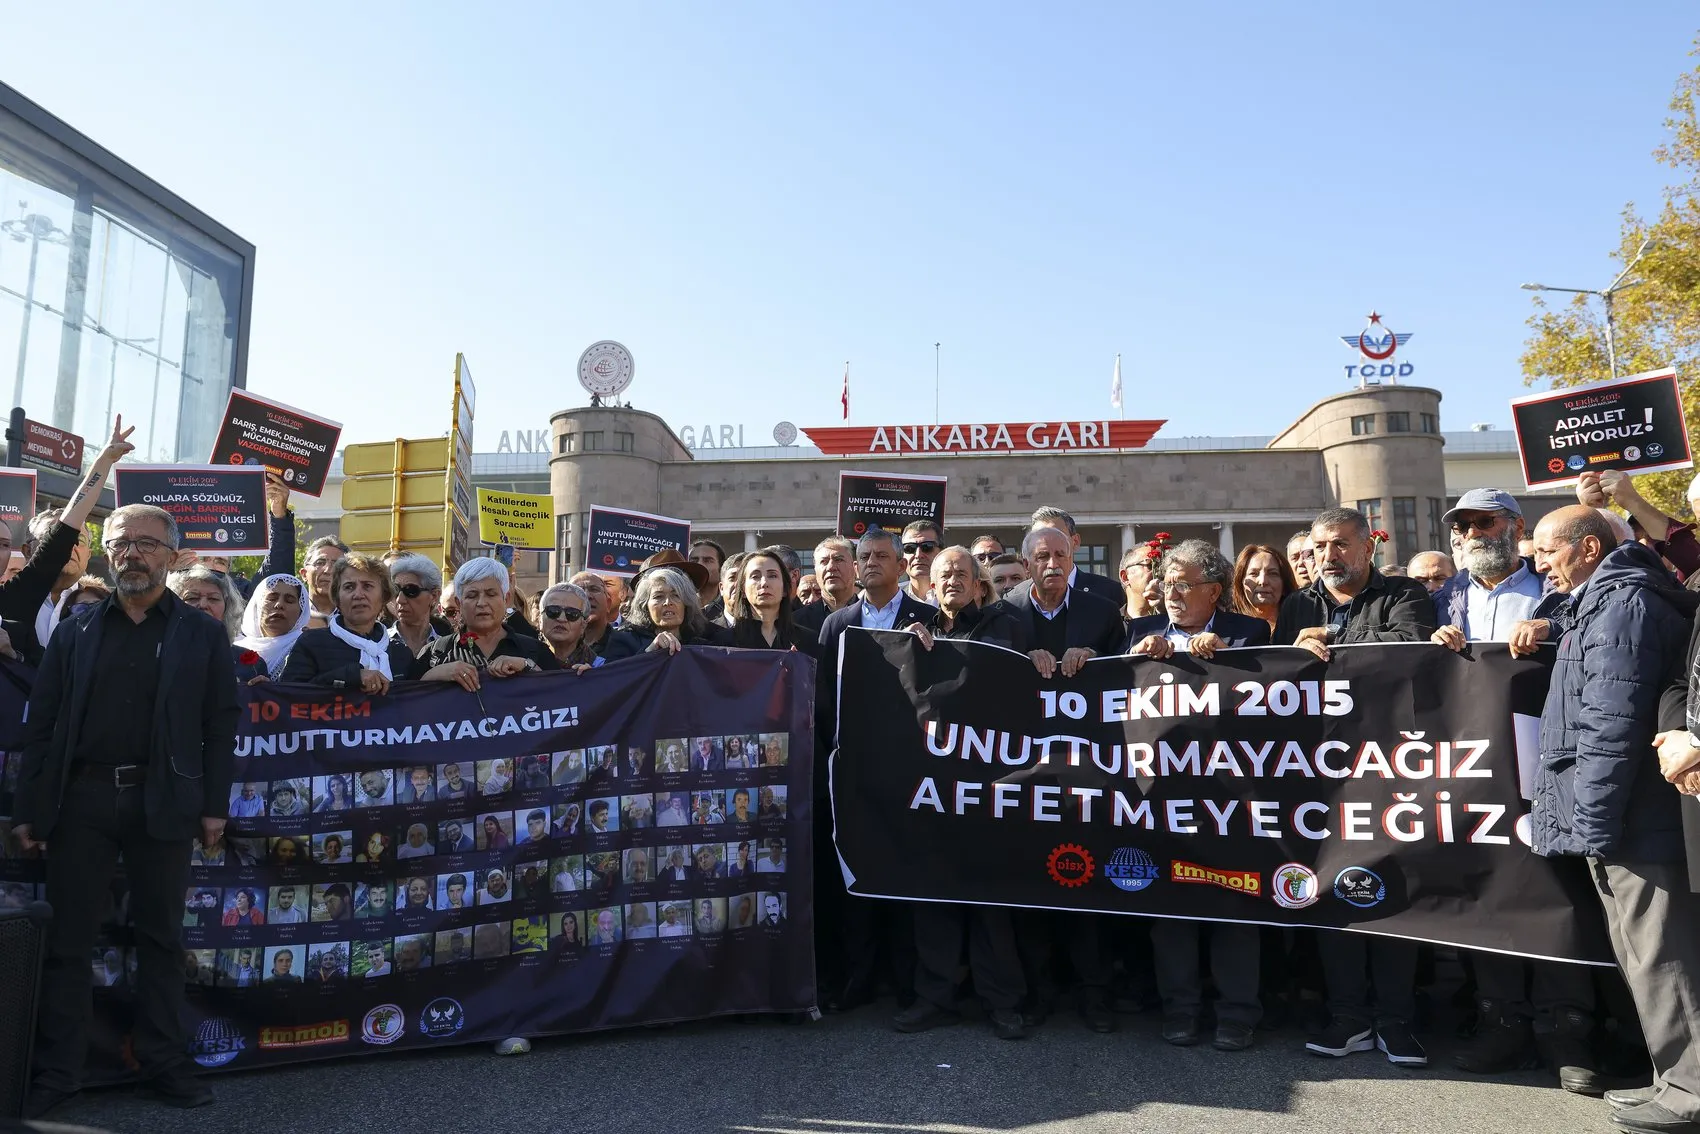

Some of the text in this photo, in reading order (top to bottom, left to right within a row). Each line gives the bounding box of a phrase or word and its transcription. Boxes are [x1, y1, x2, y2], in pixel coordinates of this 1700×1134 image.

[1344, 361, 1414, 378] TCDD
[1564, 401, 1574, 409] 10
[1555, 408, 1626, 432] ADALET
[30, 424, 63, 442] DEMOKRASİ
[232, 417, 257, 432] BARIŞ,
[259, 426, 283, 439] EMEK,
[283, 433, 327, 453] DEMOKRASİ
[497, 424, 744, 453] ANK GARI
[870, 421, 1110, 452] ANKARA GARI
[27, 442, 54, 457] MEYDANI
[242, 430, 311, 457] MÜCADELESİNDEN
[1589, 453, 1620, 463] tmmob
[143, 493, 246, 504] ONLARA SÖZÜMÜZ,
[487, 495, 538, 508] Katillerden
[848, 497, 929, 508] UNUTTURMAYACAĞIZ
[0, 505, 20, 514] TUR,
[162, 504, 241, 515] EĞİN, BARIŞIN,
[481, 505, 550, 520] Hesabı Gençlik
[175, 514, 256, 524] RASİNİN ÜLKESİ
[494, 518, 535, 529] Soracak!
[185, 531, 212, 539] tmmob
[598, 530, 673, 548] UNUTTURMAYACAĞIZ
[1041, 673, 1354, 721] 10 EKİM 2015
[247, 696, 370, 722] 10 EKİM
[233, 706, 579, 757] UNUTTURMAYACAĞIZ!
[924, 720, 1493, 780] UNUTTURMAYACAĞIZ
[1057, 858, 1085, 872] DİSK
[1104, 864, 1160, 879] KESK
[1121, 879, 1142, 887] 1995
[1173, 862, 1259, 891] tmmob
[261, 1020, 347, 1044] tmmob
[189, 1037, 246, 1052] KESK
